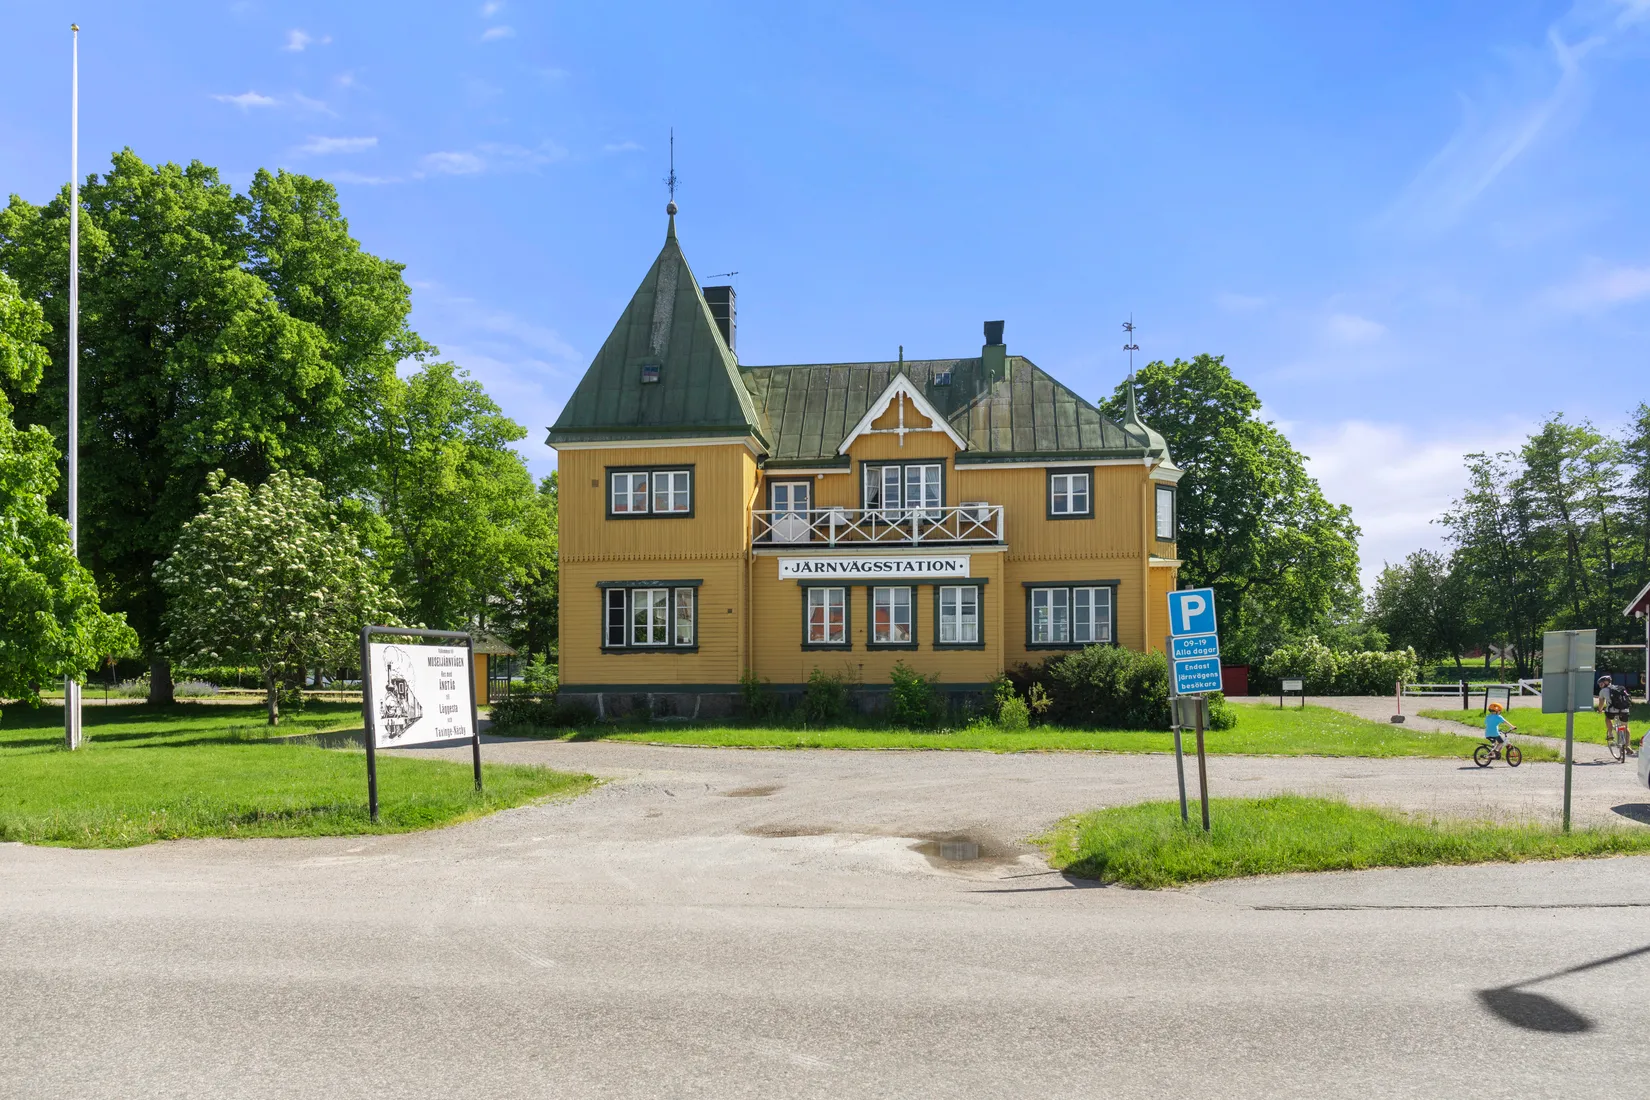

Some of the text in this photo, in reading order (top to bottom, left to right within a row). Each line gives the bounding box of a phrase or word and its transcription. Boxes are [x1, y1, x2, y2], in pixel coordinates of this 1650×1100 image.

[792, 560, 956, 572] JÄRNVÄGSSTATION
[1180, 595, 1206, 631] P
[1183, 639, 1207, 647] 09-19
[1176, 647, 1216, 656] Alla dagar
[1178, 672, 1219, 682] järnvägens
[1181, 681, 1217, 690] besökare
[439, 704, 458, 715] Läggesta
